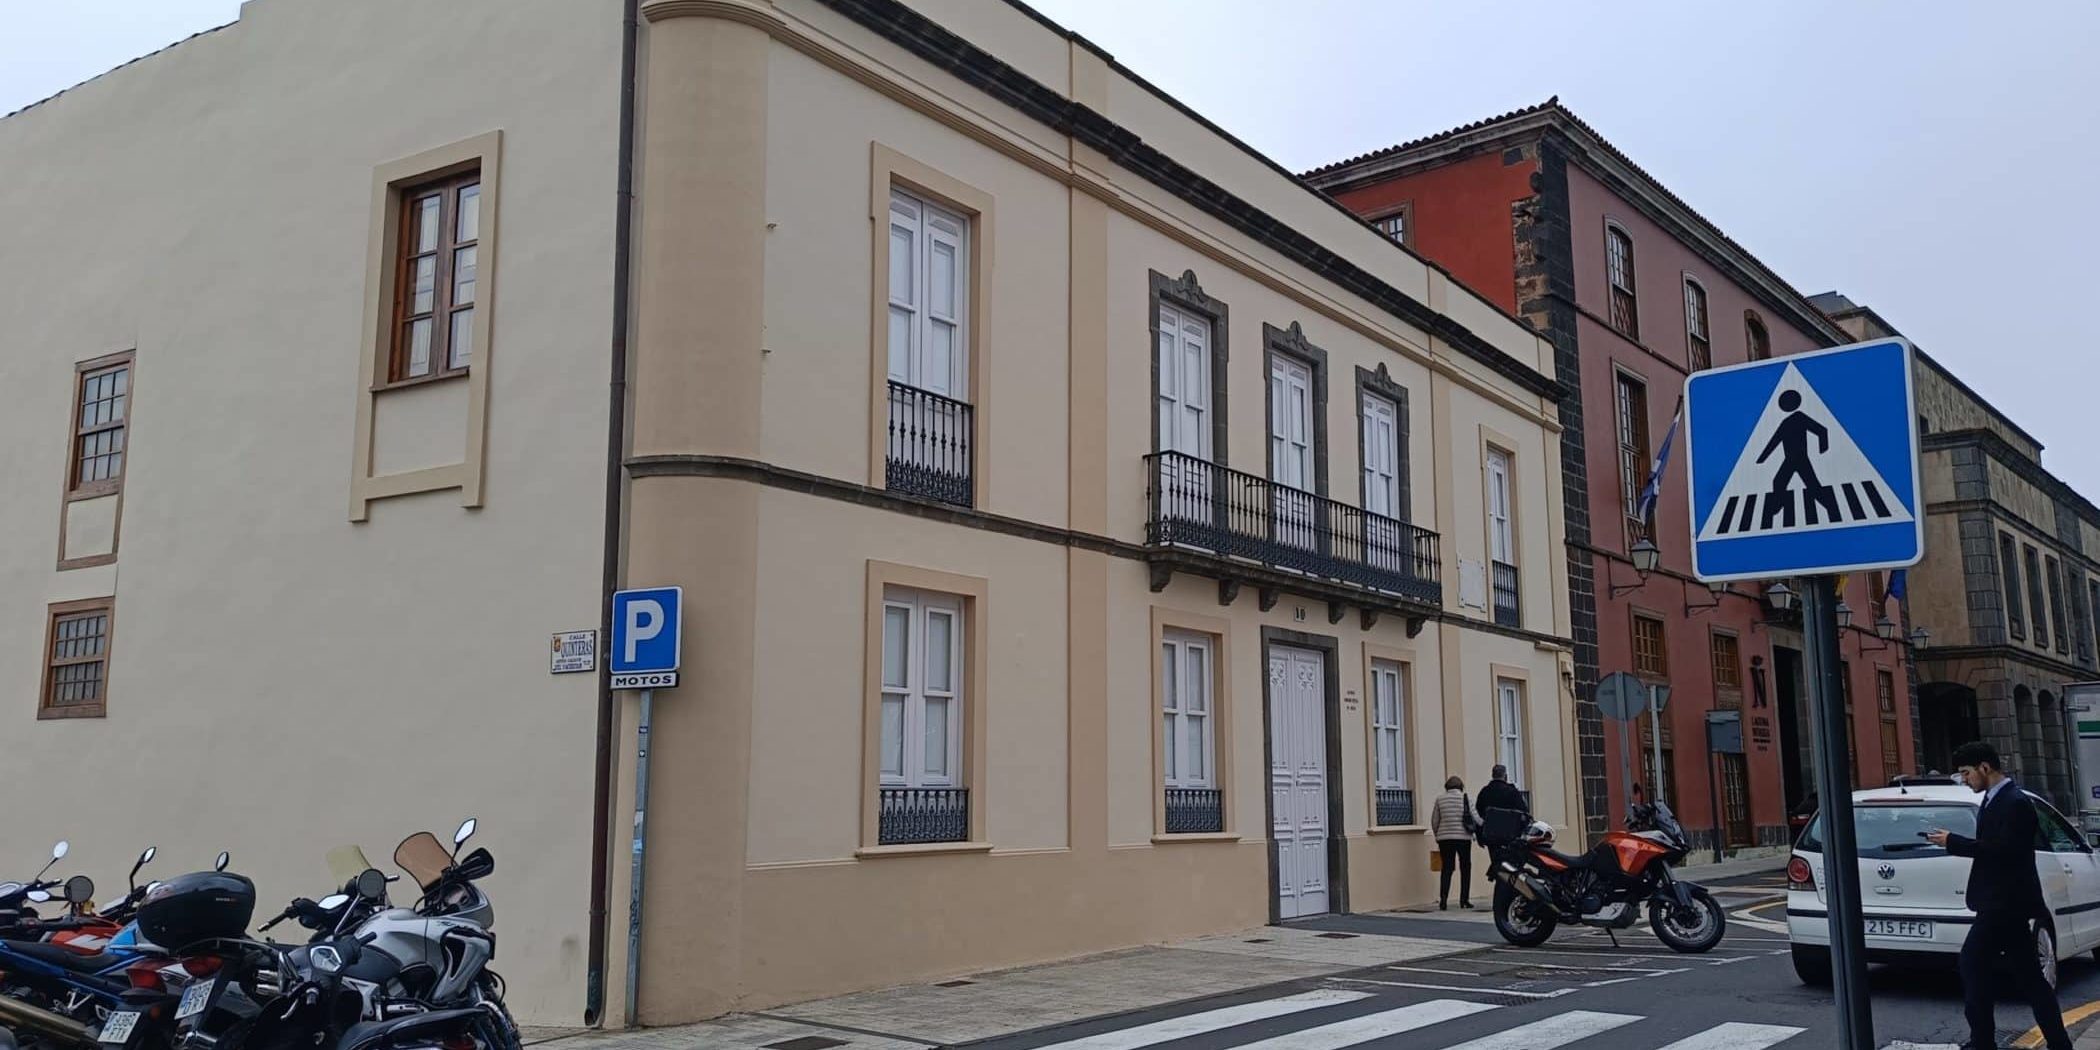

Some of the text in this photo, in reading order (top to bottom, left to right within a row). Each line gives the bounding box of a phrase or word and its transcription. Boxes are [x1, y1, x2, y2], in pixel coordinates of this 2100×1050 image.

[1296, 606, 1306, 620] 10
[624, 599, 665, 663] P
[615, 675, 672, 686] MOTOS
[1899, 922, 1927, 935] FFC
